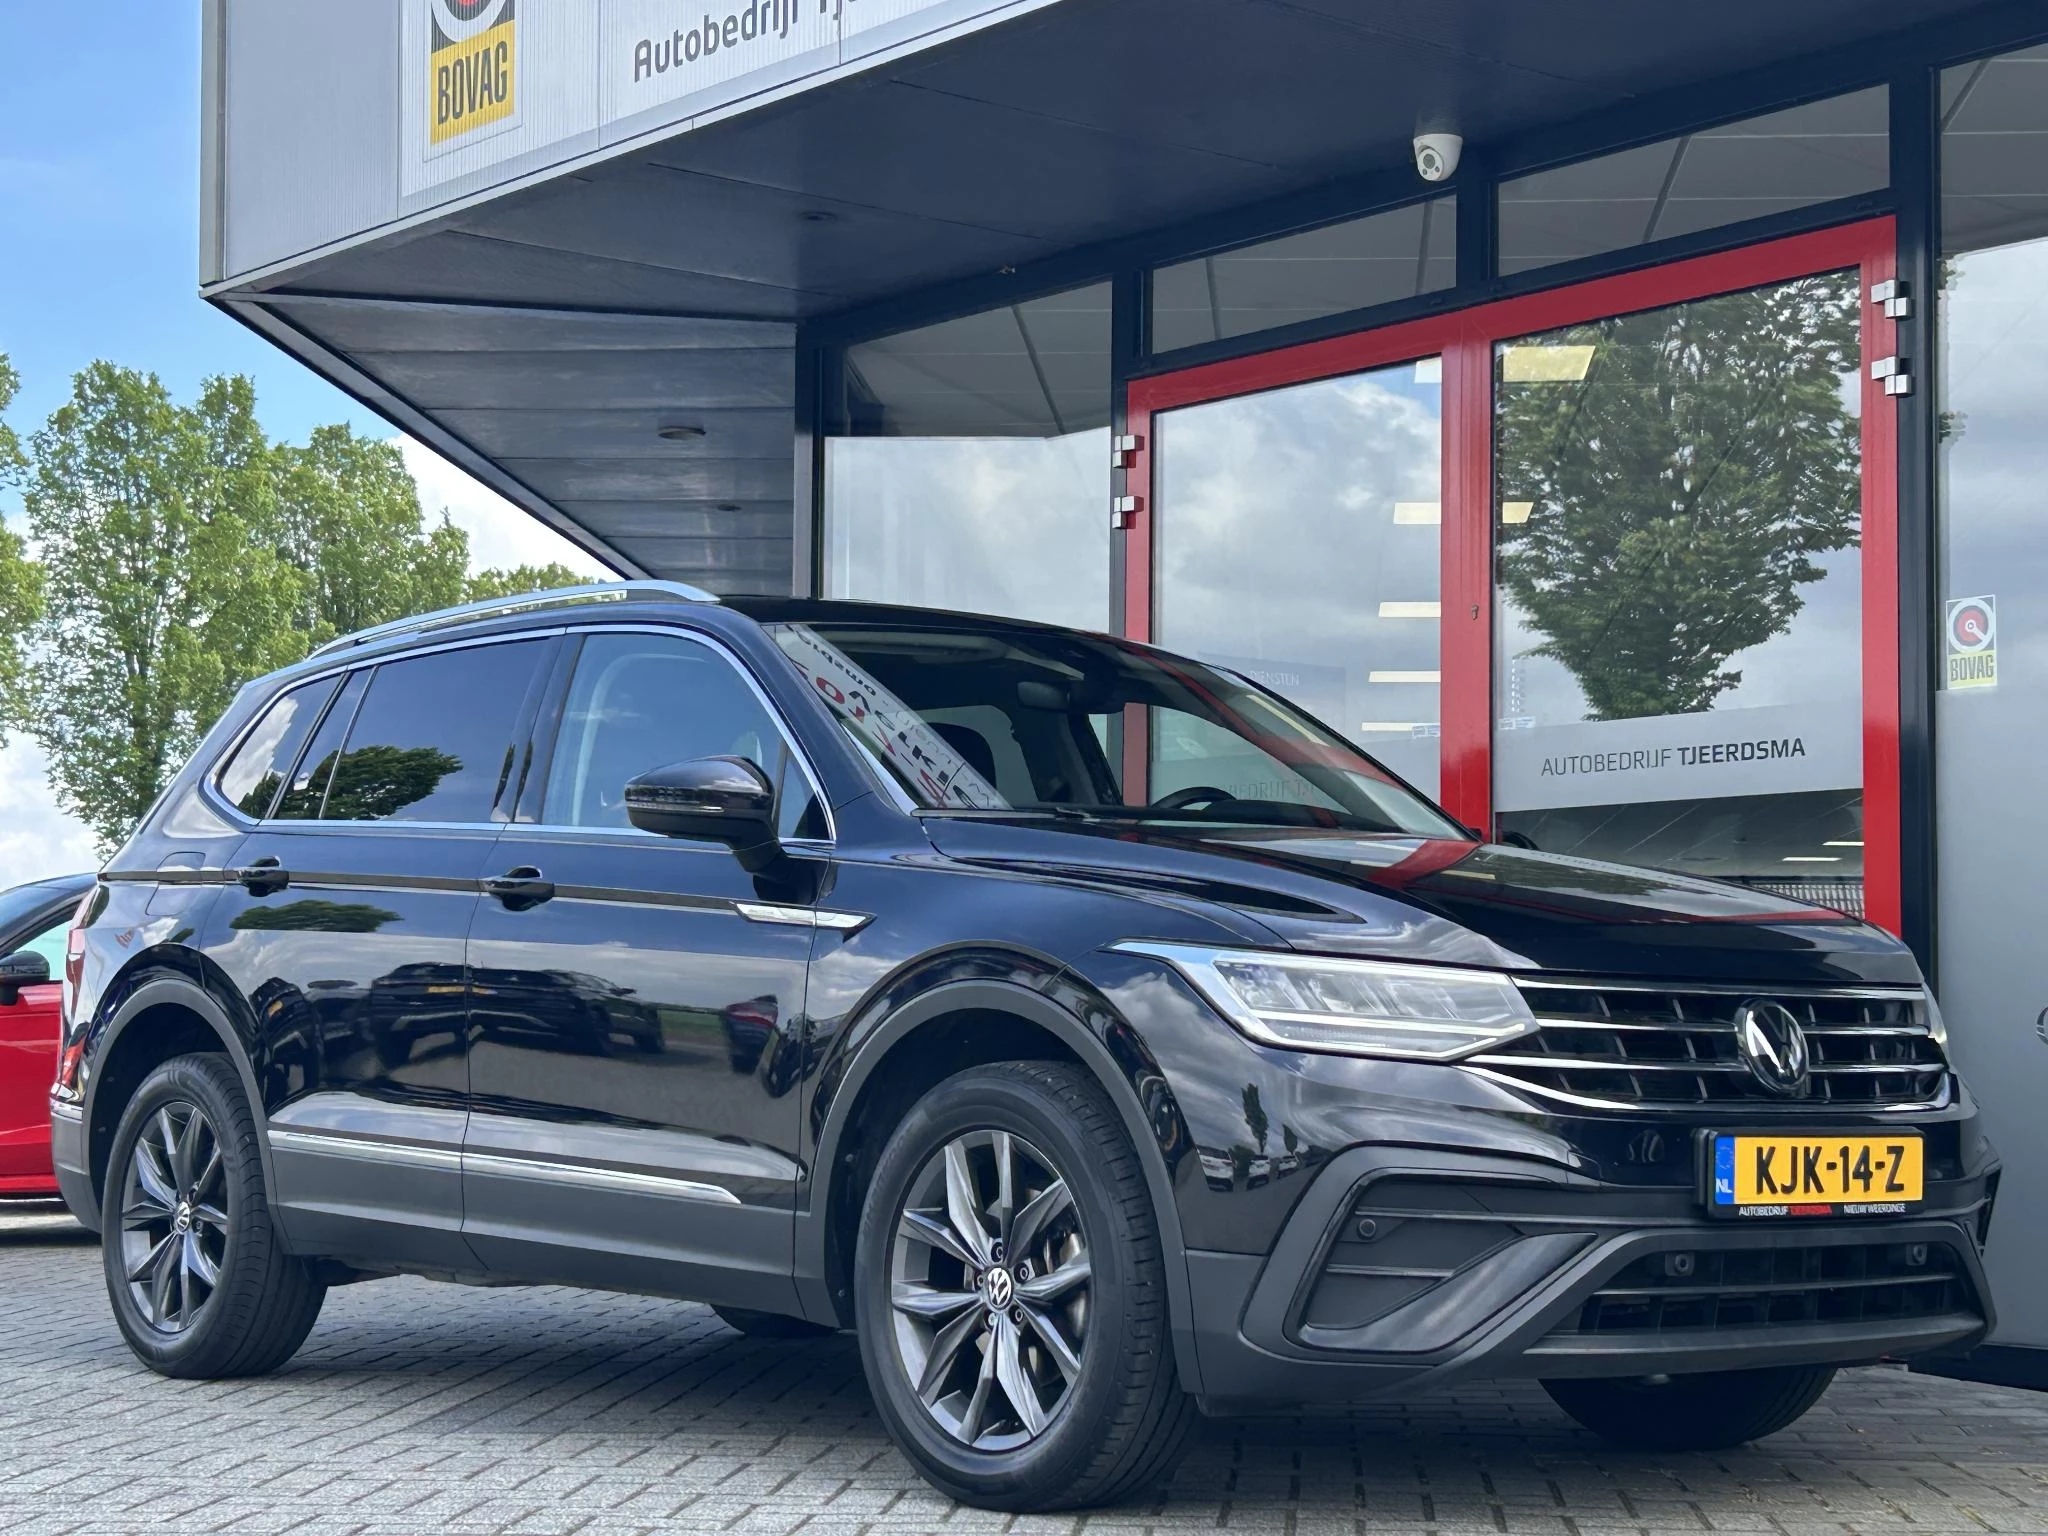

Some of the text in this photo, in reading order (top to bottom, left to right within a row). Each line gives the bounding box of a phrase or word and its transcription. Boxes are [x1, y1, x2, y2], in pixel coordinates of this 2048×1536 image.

[438, 40, 508, 125] BOVAG
[1950, 654, 1994, 681] BOVAG
[1541, 738, 1806, 776] AUTOBEDRIJF TJEERDSMA
[1715, 1178, 1732, 1193] NL
[1756, 1145, 1905, 1195] KJK-14-Z
